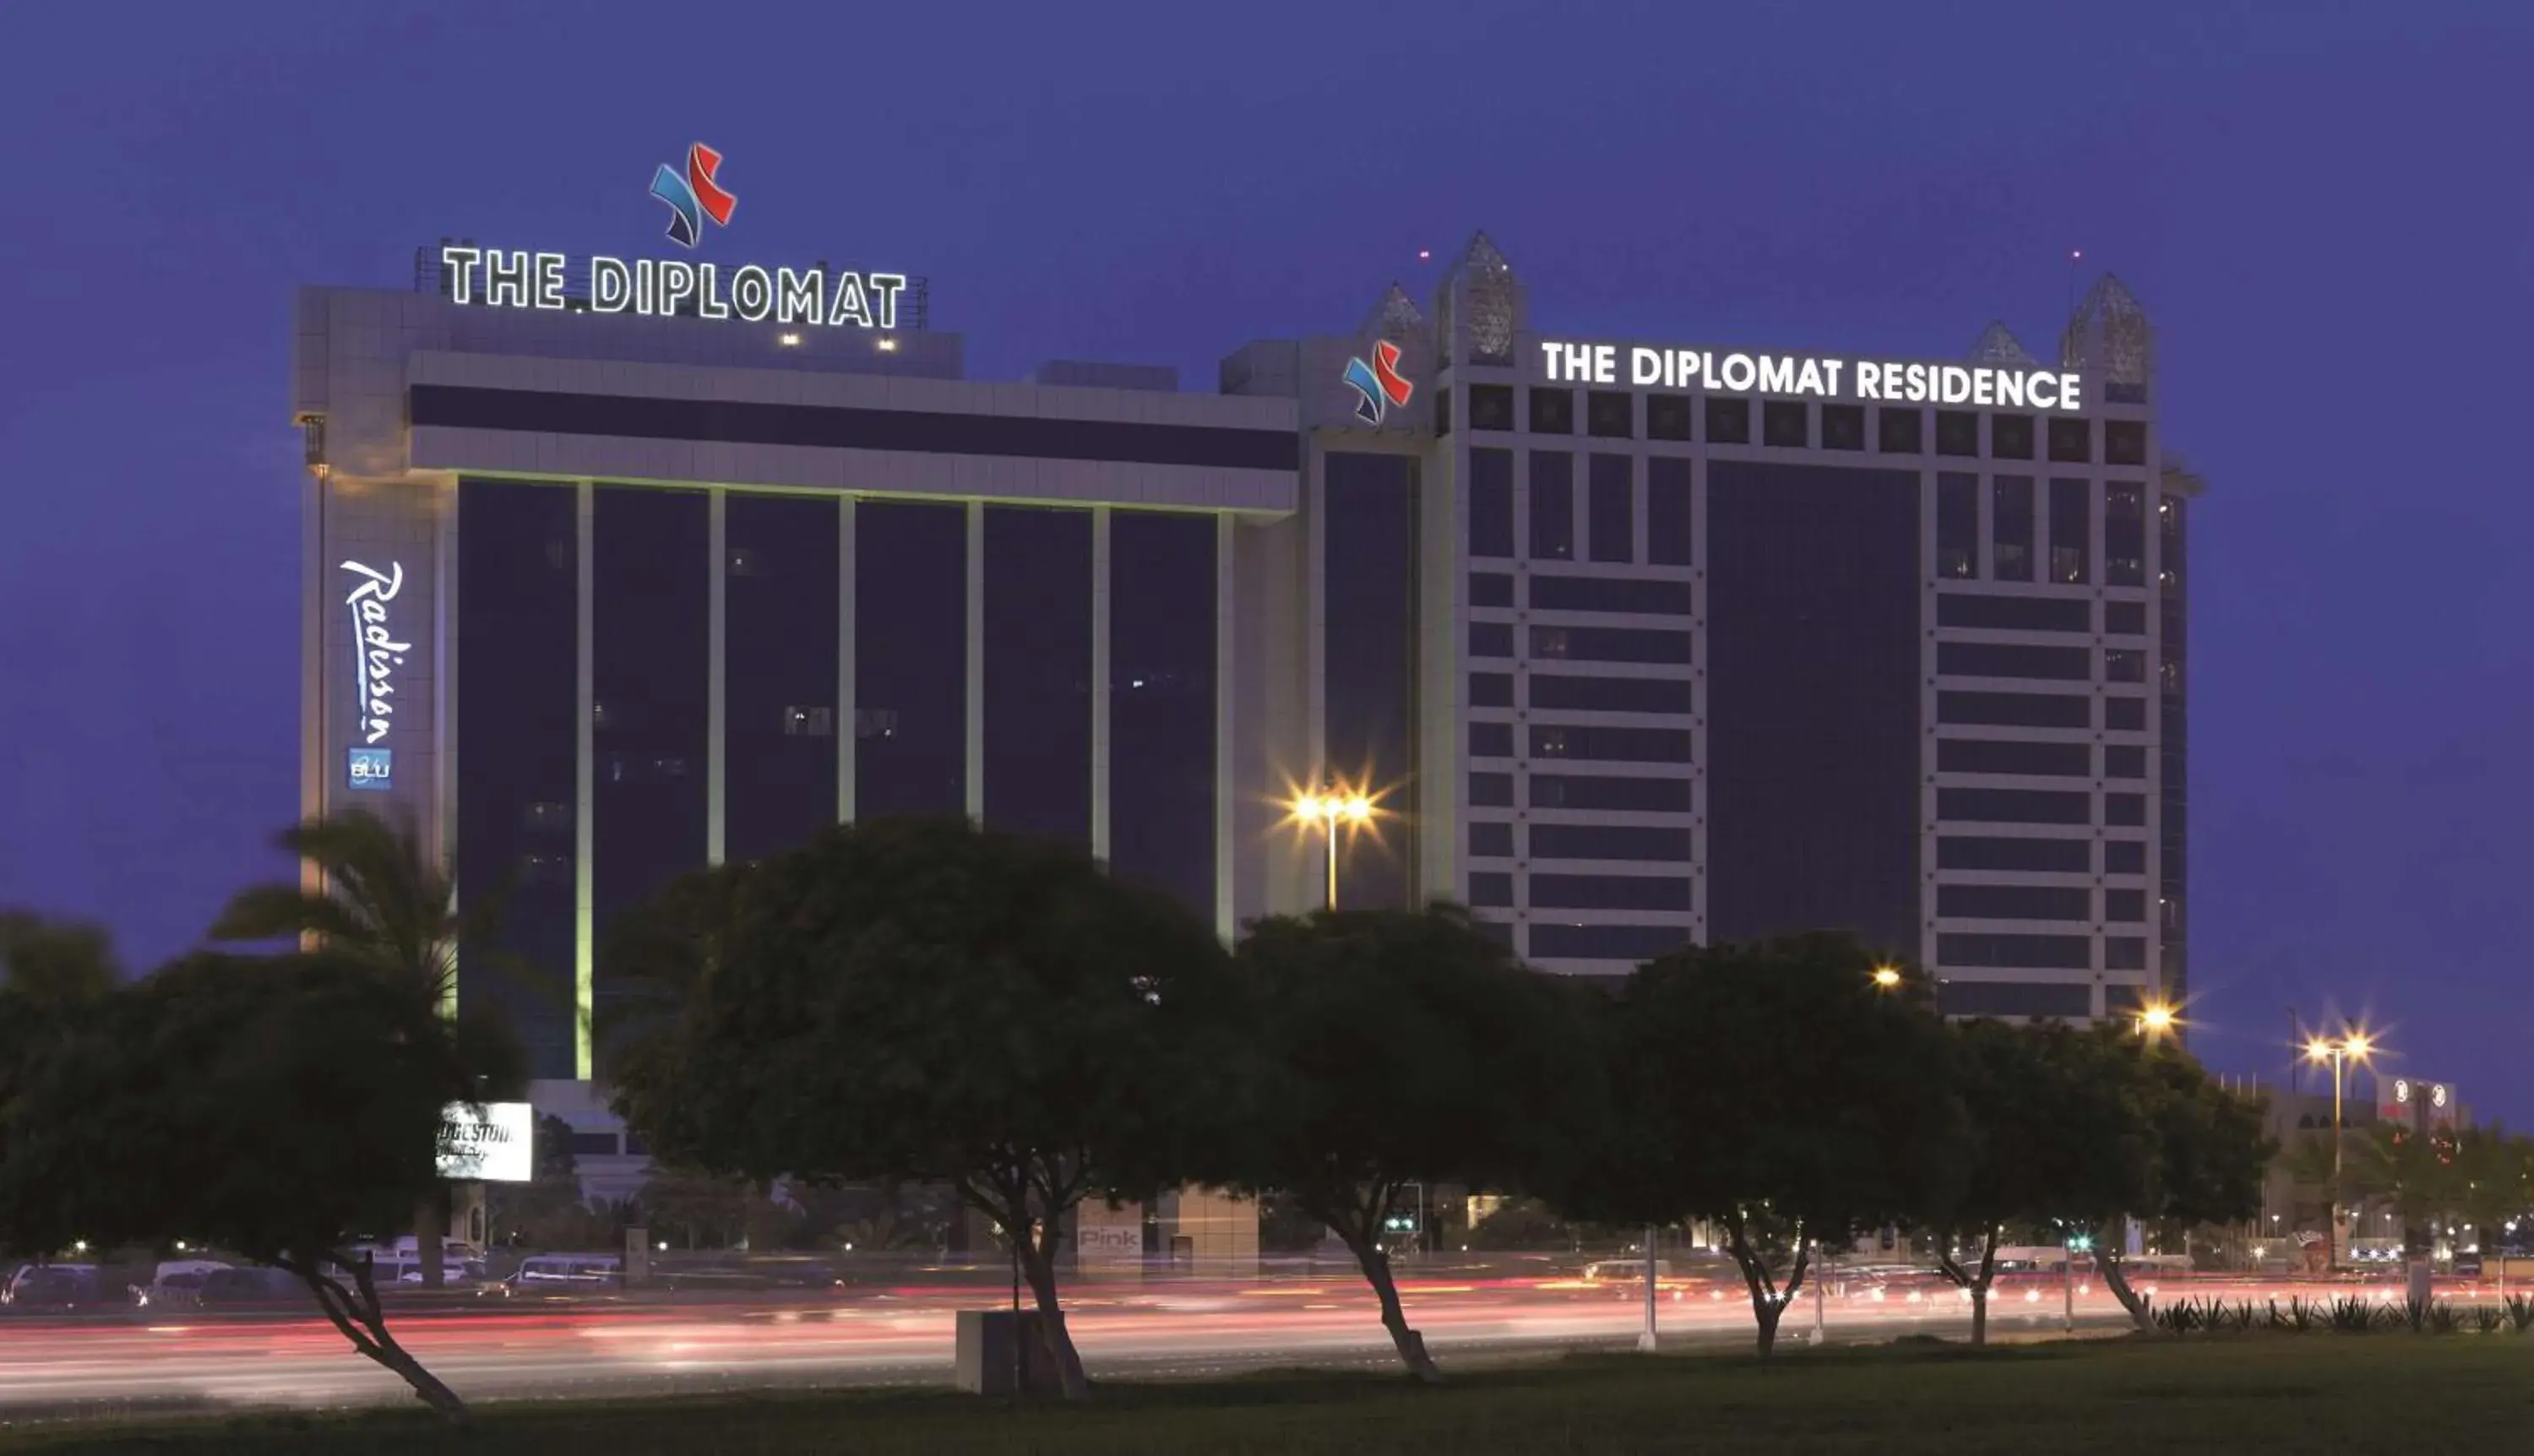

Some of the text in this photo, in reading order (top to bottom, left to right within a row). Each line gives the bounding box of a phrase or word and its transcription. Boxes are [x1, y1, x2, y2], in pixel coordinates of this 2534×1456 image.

[443, 247, 906, 329] THE DIPLOMAT
[1542, 342, 2080, 410] THE DIPLOMAT RESIDENCE
[340, 560, 412, 744] Radisson
[351, 763, 389, 778] BLU
[1079, 1227, 1139, 1246] Pink
